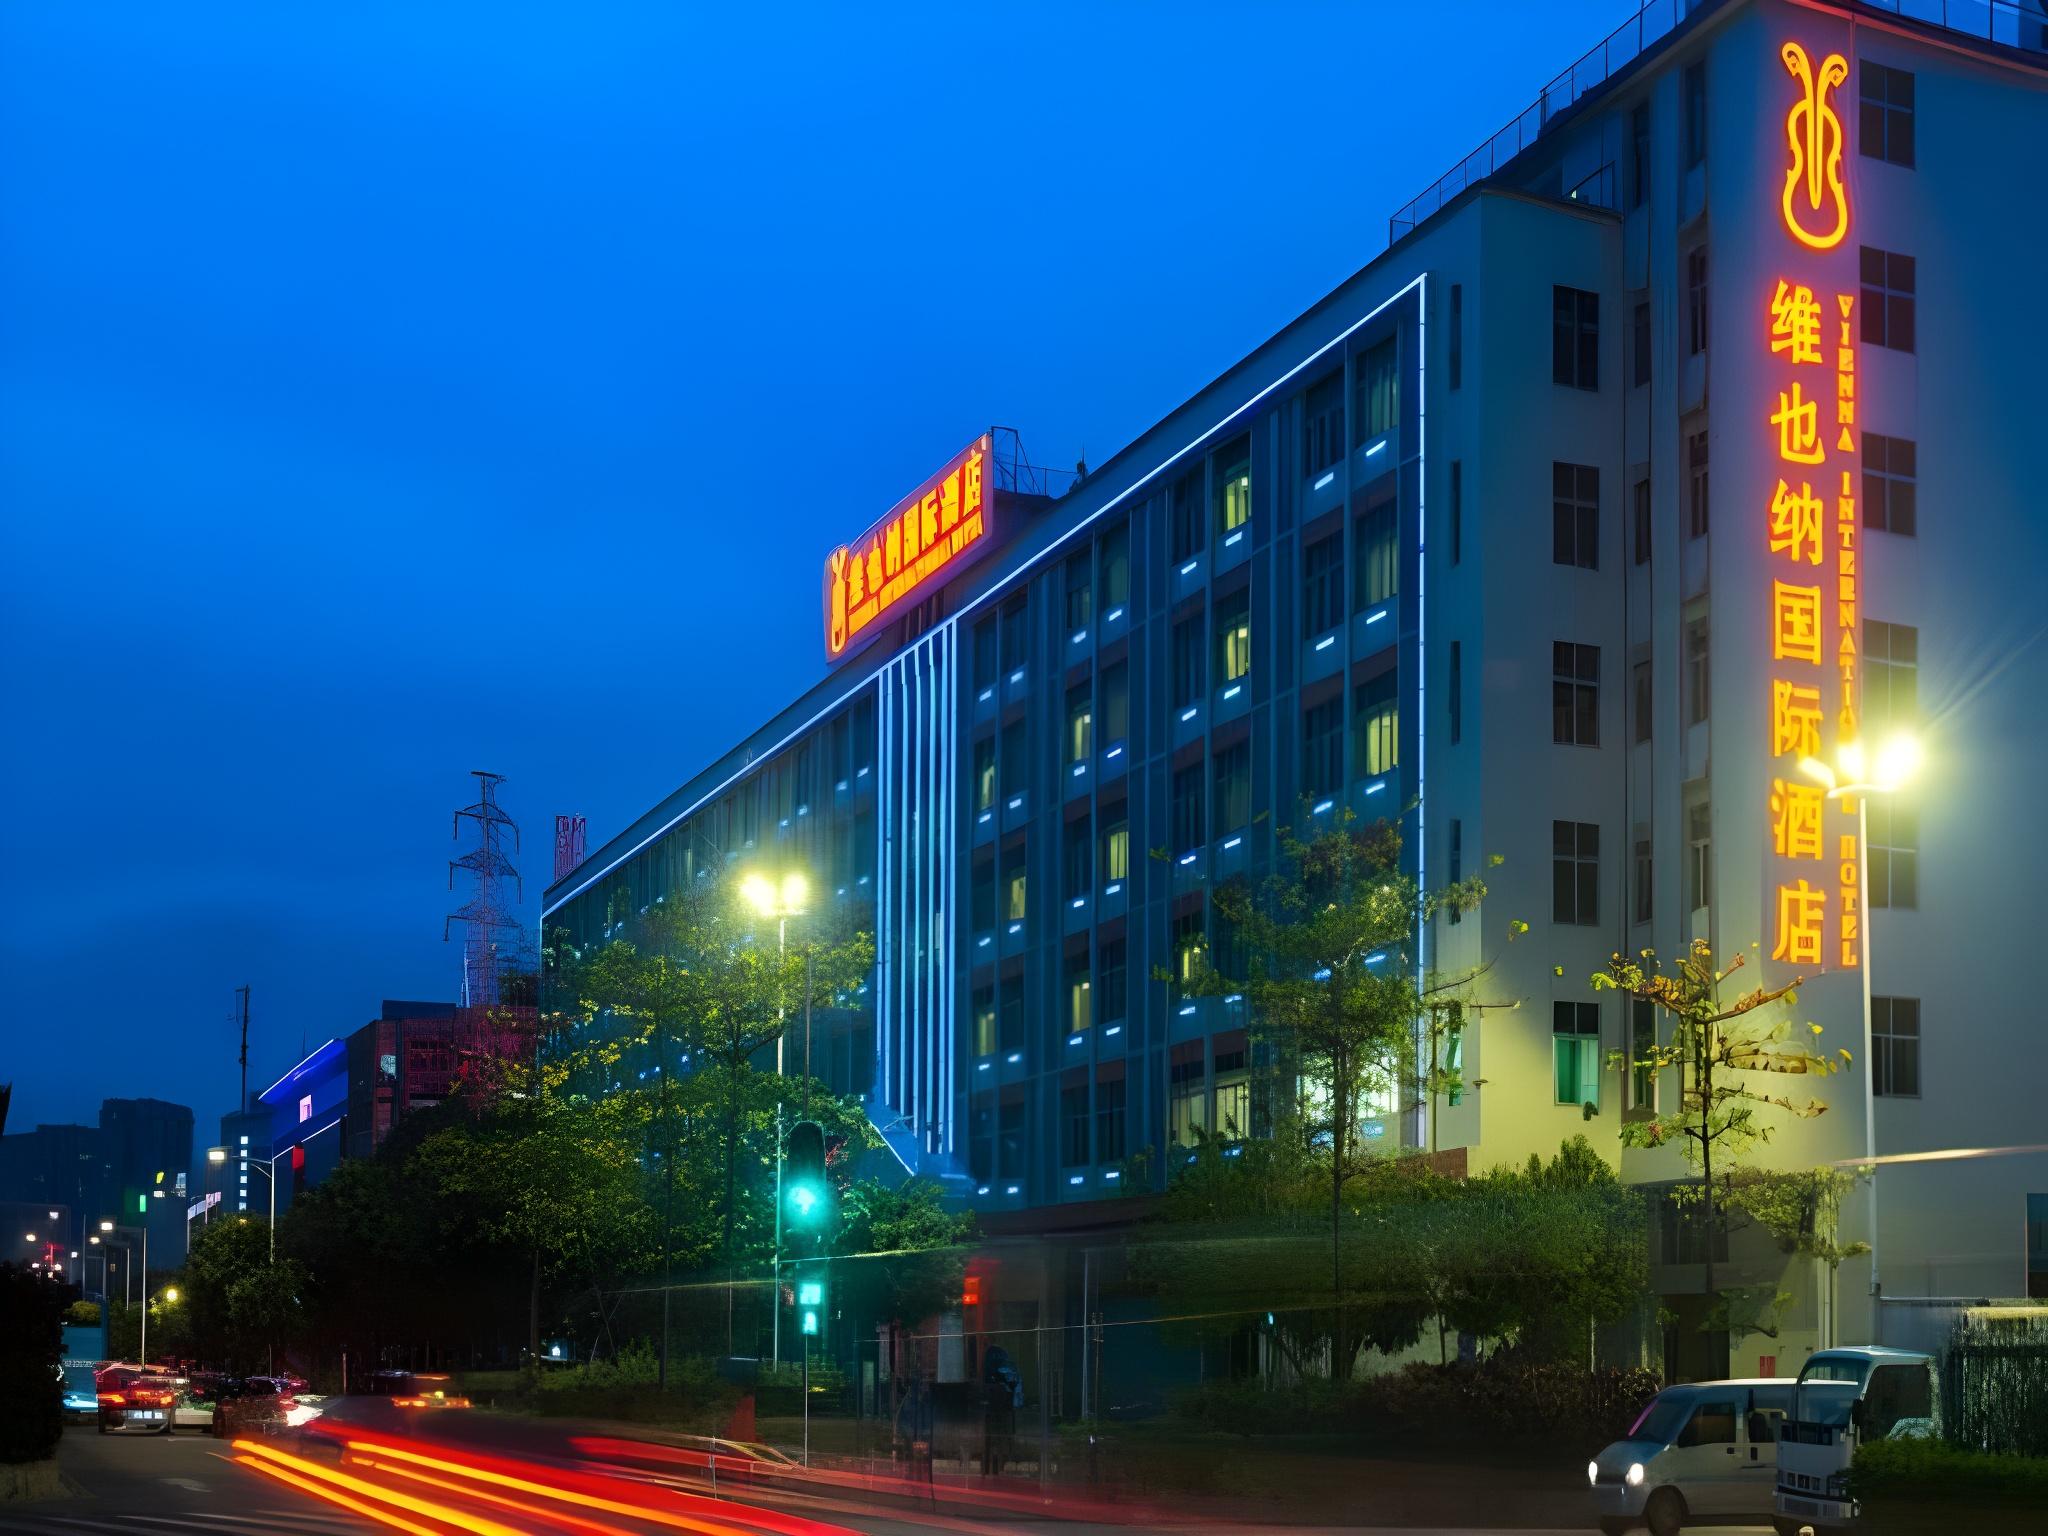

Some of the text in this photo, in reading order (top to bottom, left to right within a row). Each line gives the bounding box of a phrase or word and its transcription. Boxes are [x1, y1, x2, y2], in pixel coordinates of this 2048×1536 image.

[1837, 294, 1856, 452] VIENNA
[1769, 278, 1826, 965] 维也纳国际酒店
[1839, 835, 1858, 966] HOTEL
